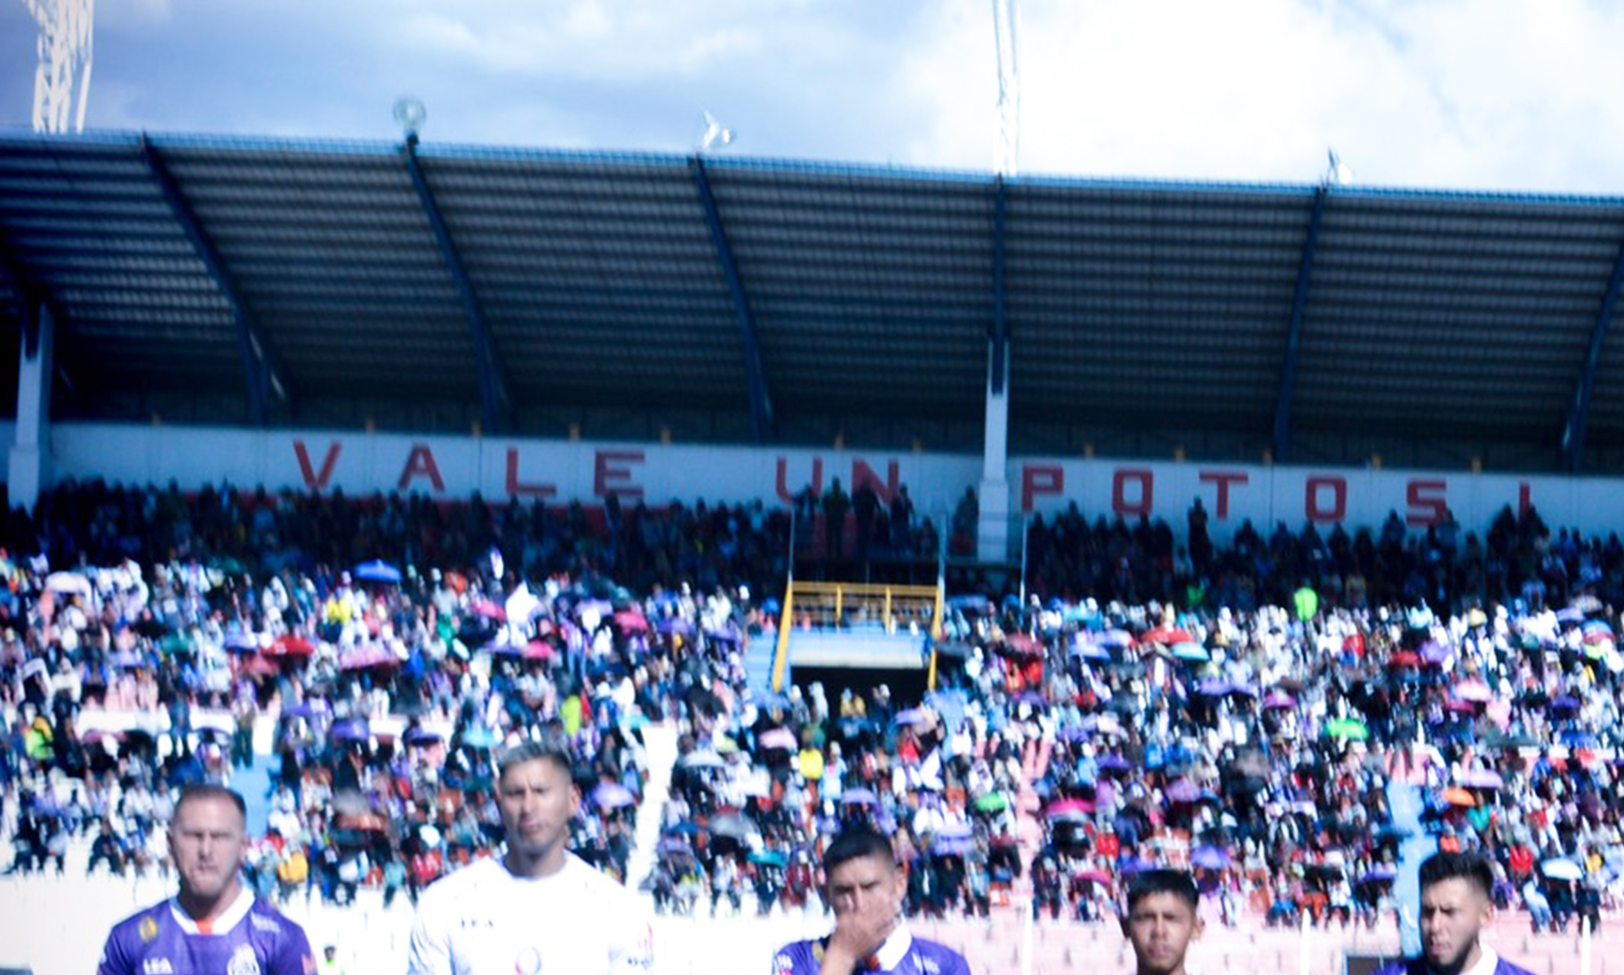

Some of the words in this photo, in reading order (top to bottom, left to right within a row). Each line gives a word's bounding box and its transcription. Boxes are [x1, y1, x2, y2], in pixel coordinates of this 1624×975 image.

[292, 438, 647, 499] VALE
[775, 454, 900, 506] UN
[1020, 462, 1531, 528] POTOSI
